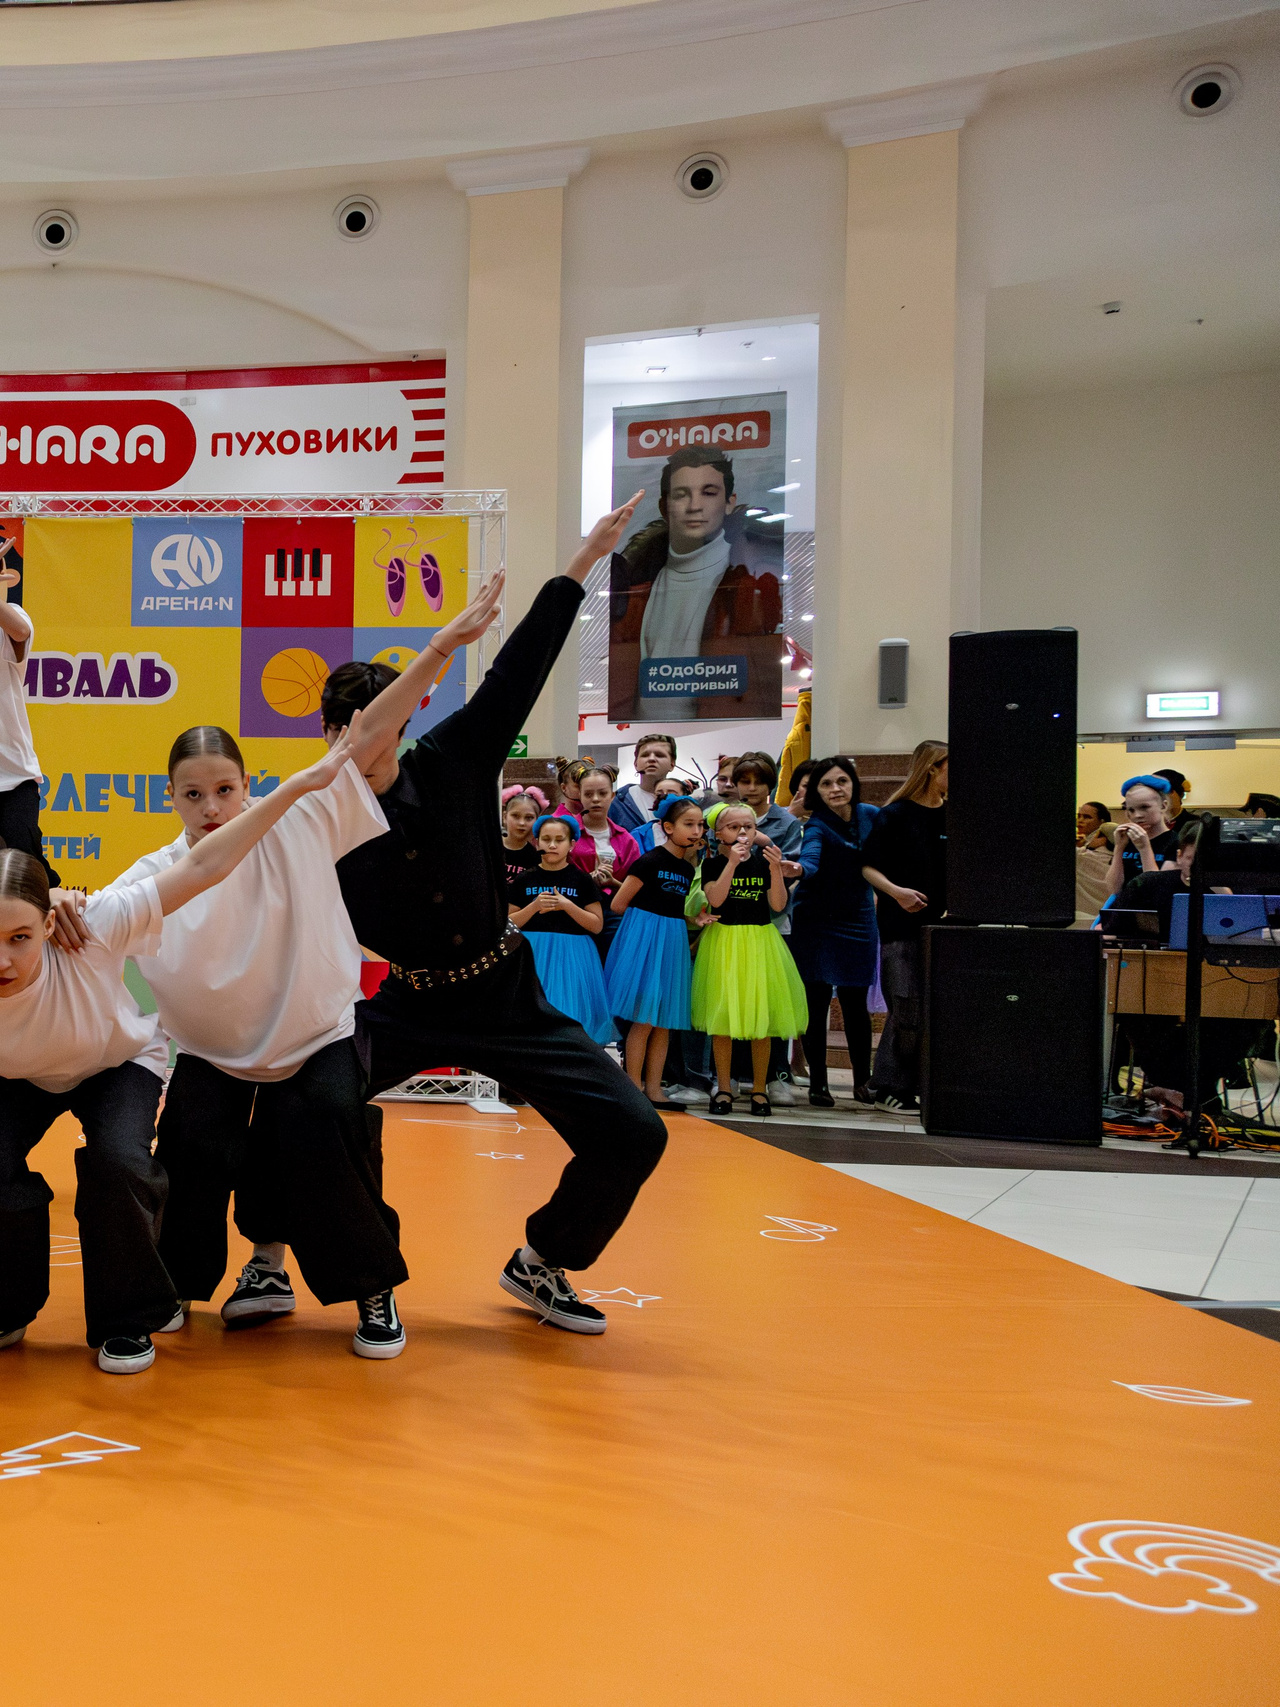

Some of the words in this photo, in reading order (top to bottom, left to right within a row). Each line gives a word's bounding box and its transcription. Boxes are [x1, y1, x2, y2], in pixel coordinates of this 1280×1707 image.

[211, 426, 398, 458] ПУХОВИКИ
[638, 420, 759, 449] O'HARA
[648, 662, 738, 678] #Одобрил
[648, 678, 739, 693] Кологривый
[525, 886, 579, 898] BEAUTFUL
